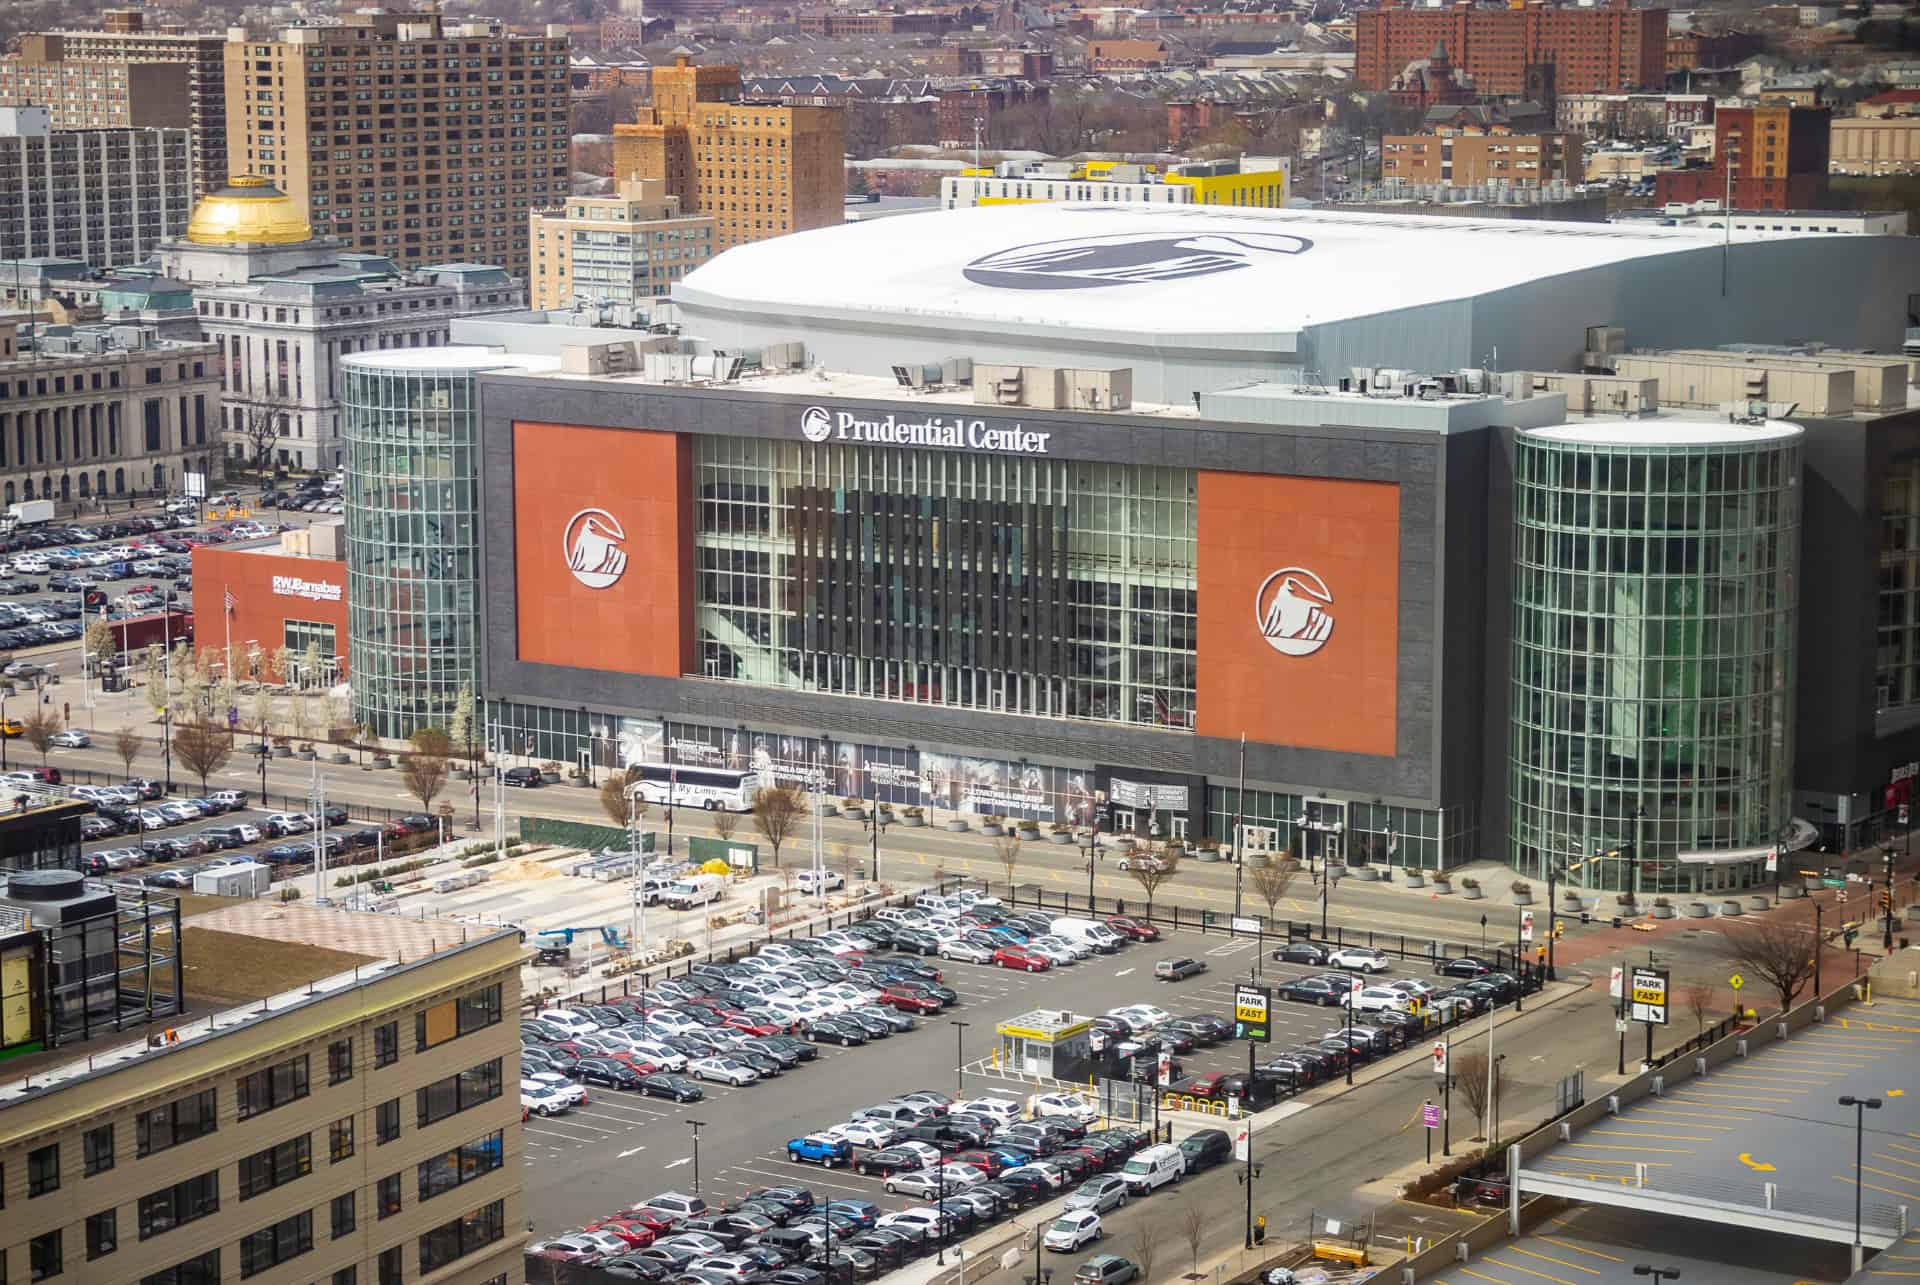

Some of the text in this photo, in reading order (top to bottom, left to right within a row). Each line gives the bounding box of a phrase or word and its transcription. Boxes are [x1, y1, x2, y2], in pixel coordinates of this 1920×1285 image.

[836, 412, 1050, 453] Prudential Center
[273, 576, 341, 594] RWJBarnabas
[1636, 978, 1661, 989] PARK
[1239, 996, 1263, 1007] PARK
[1636, 991, 1661, 1001] FAST
[1239, 1007, 1263, 1018] FAST
